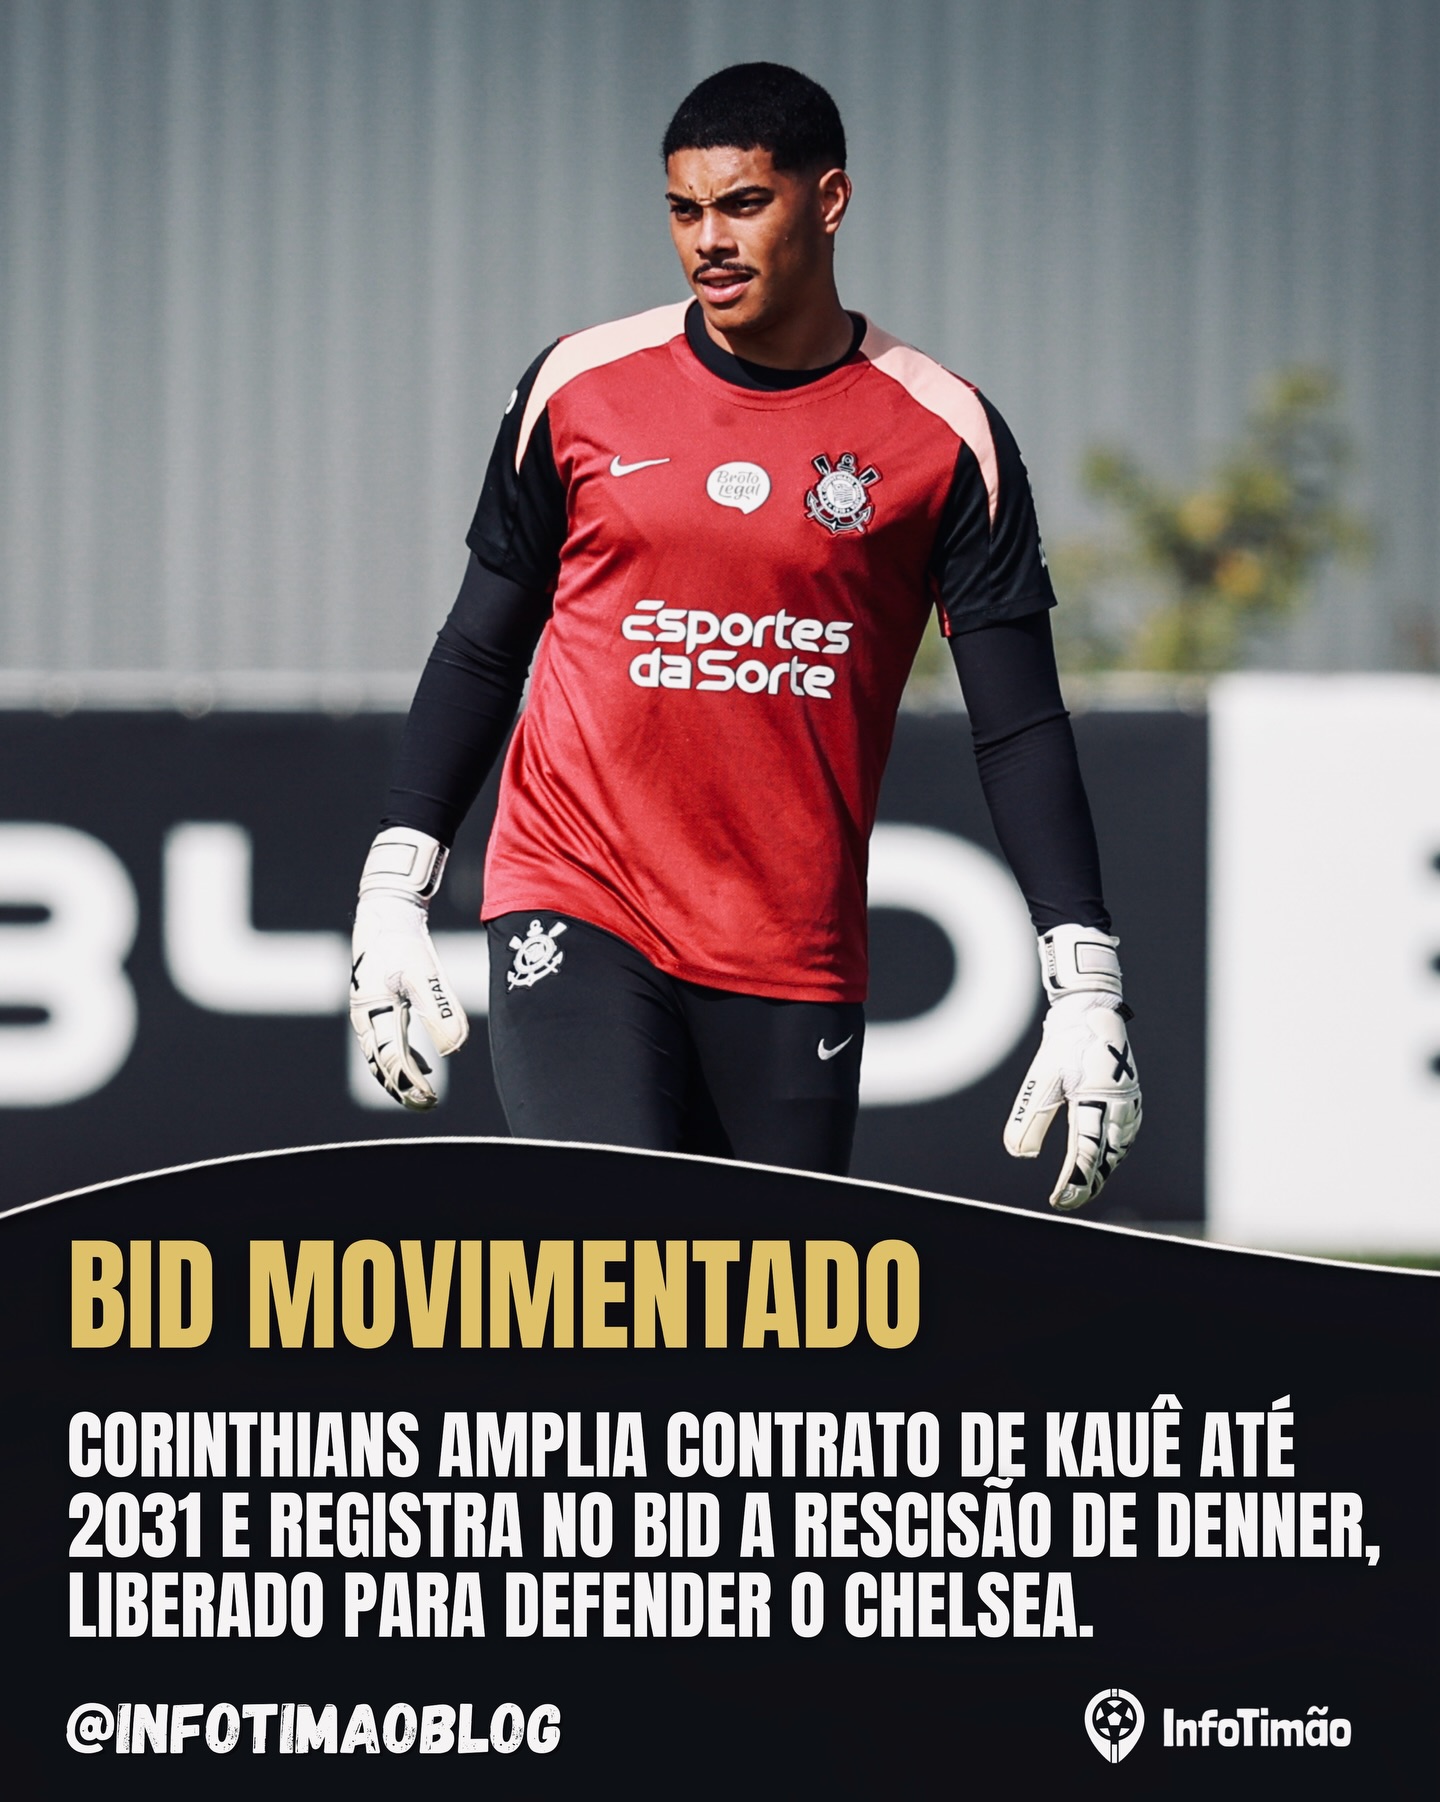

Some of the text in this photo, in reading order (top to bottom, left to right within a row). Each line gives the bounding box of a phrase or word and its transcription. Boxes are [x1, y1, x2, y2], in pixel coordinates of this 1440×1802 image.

[716, 470, 760, 485] Broto
[718, 484, 761, 500] Legal
[621, 599, 854, 655] Esportes
[695, 648, 836, 699] Sorte
[428, 977, 453, 1019] DIFAI
[1014, 1080, 1036, 1123] DIFAI
